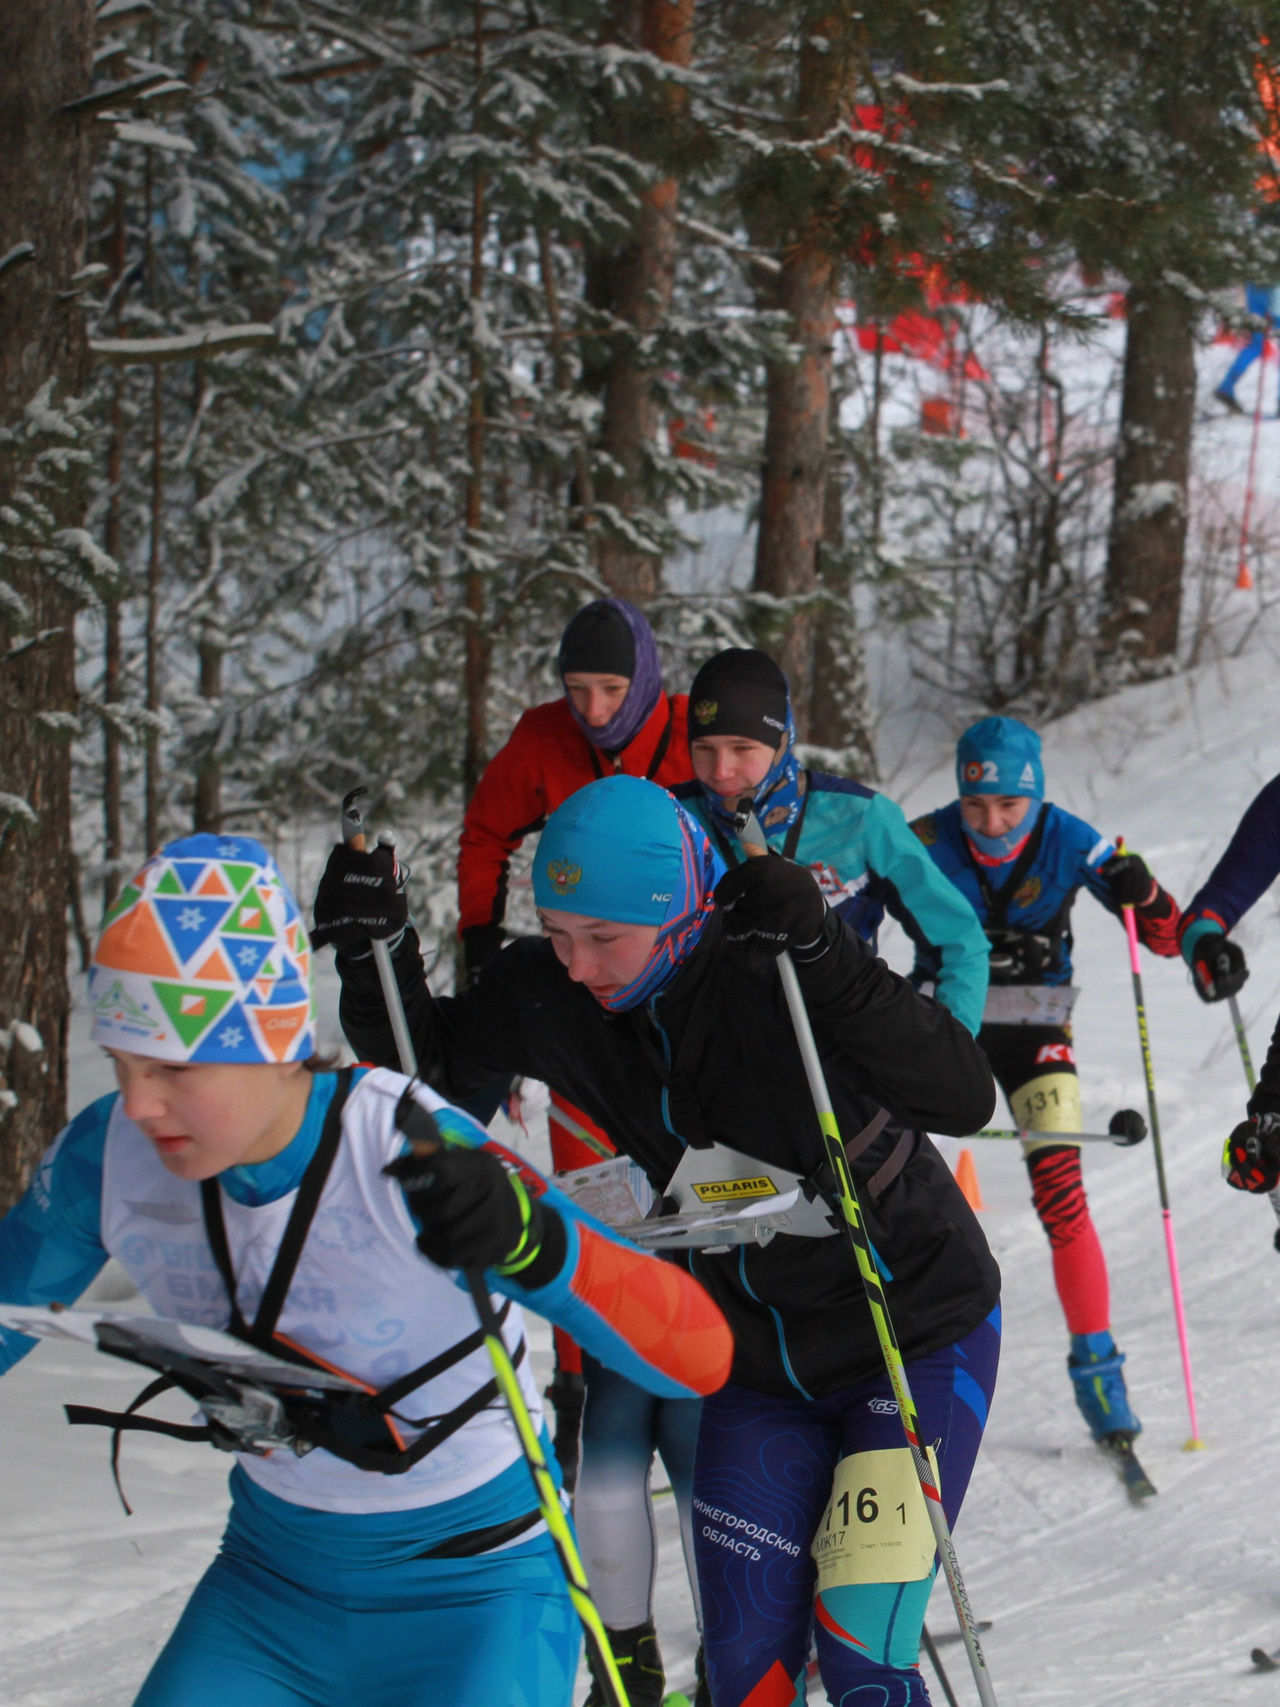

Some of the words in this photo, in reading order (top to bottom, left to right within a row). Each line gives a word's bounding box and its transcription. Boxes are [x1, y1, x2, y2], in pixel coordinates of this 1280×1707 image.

[1025, 1087, 1059, 1116] 131
[700, 1179, 769, 1195] POLARIS
[692, 1495, 801, 1558] НИЖЕГОРОДСКАЯ
[826, 1487, 879, 1532] 116
[896, 1502, 906, 1526] 1
[702, 1525, 762, 1561] ОБЛАСТЬ
